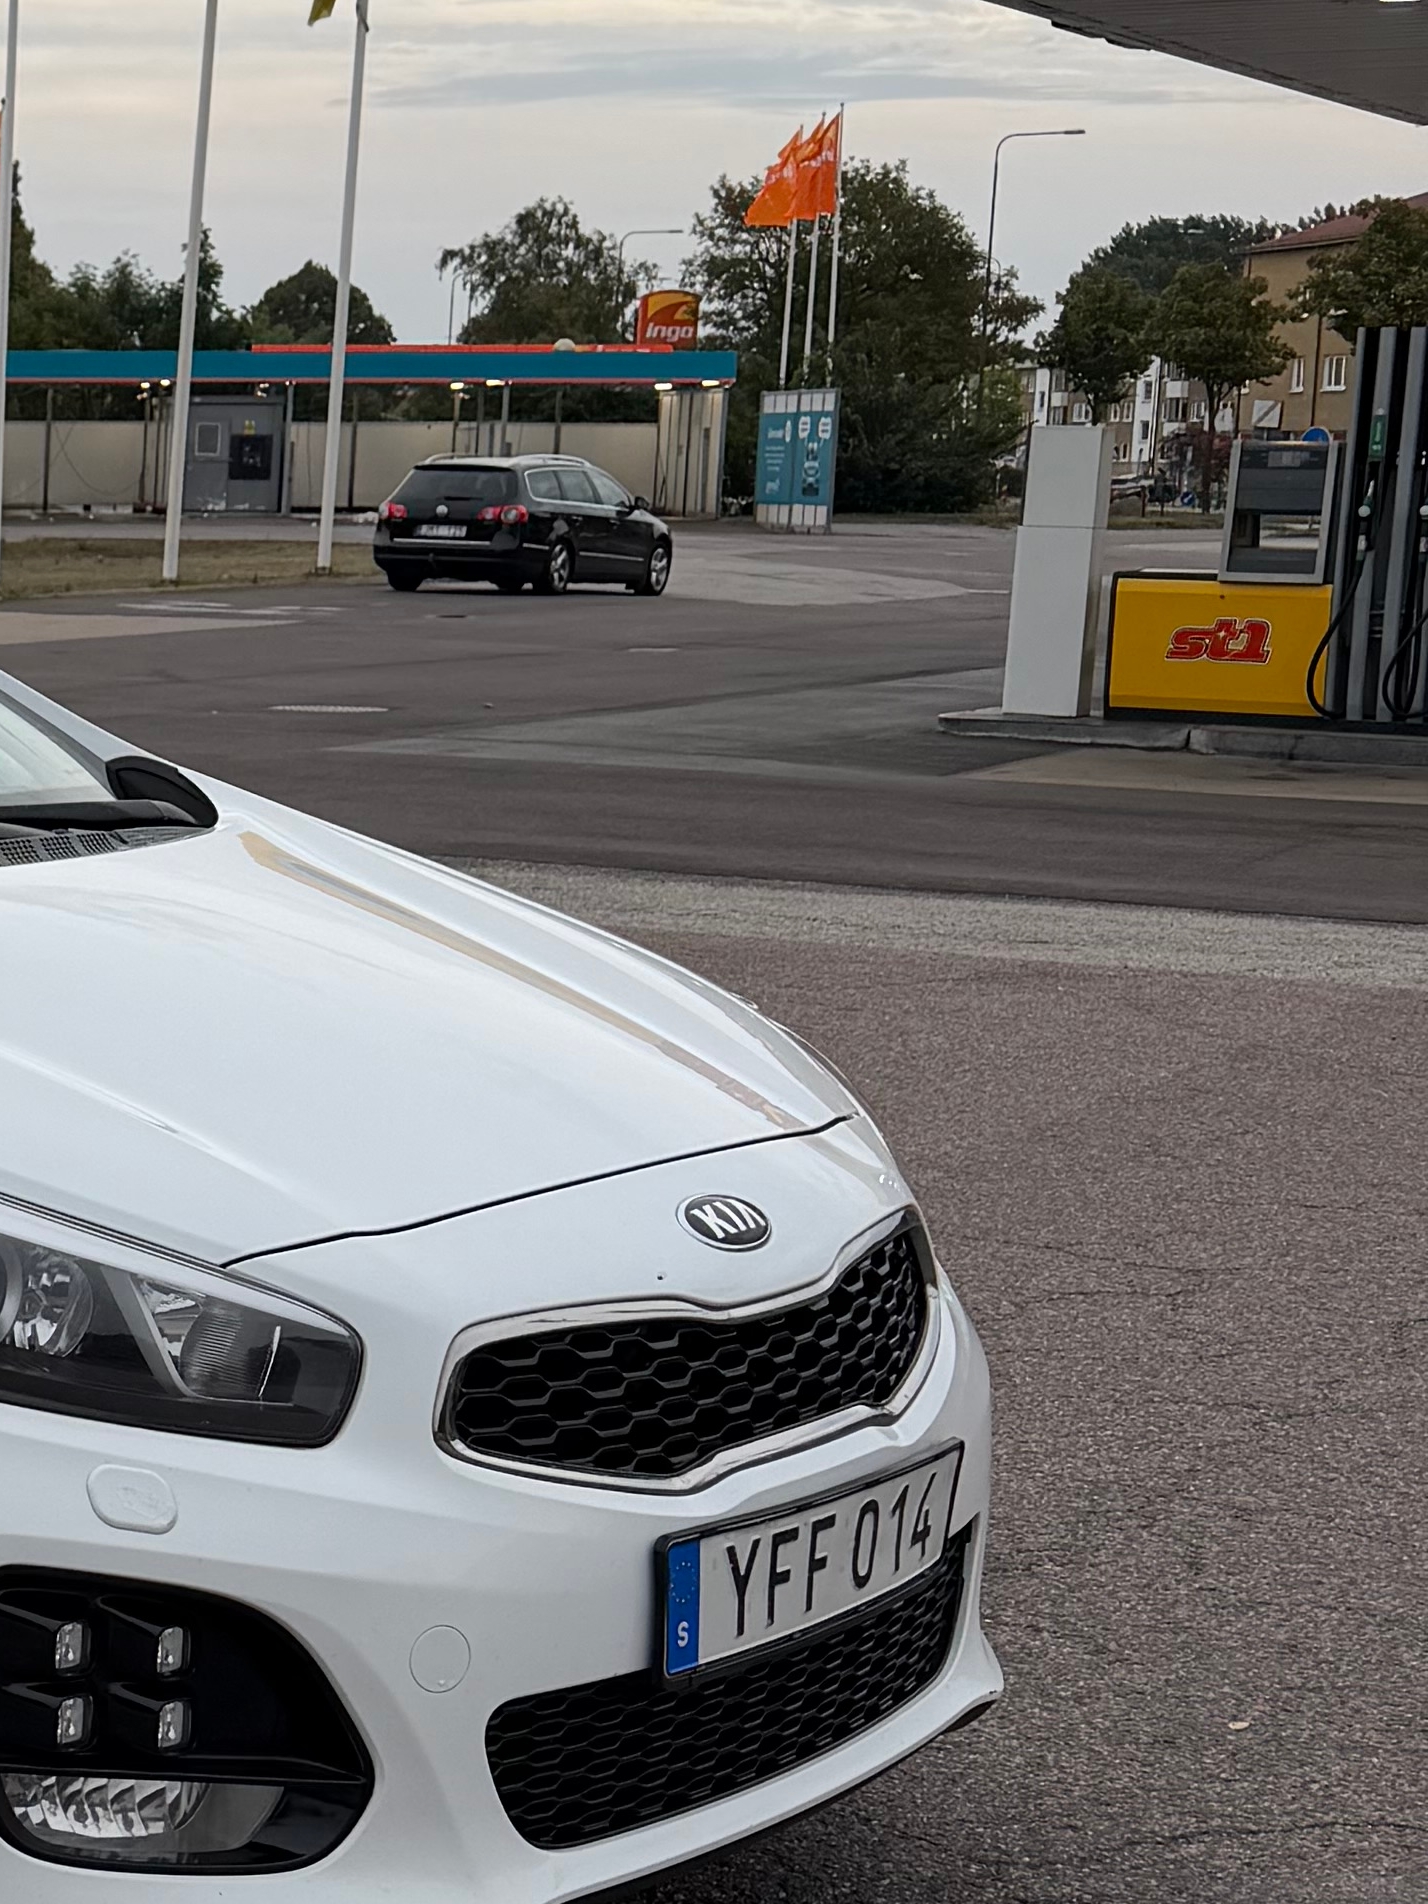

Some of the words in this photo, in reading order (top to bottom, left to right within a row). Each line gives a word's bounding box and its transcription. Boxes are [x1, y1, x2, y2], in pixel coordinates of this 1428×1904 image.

[645, 322, 694, 343] Ingo
[689, 1198, 766, 1239] KIA
[725, 1512, 837, 1639] YFF
[851, 1472, 937, 1590] 014
[677, 1621, 689, 1648] S
